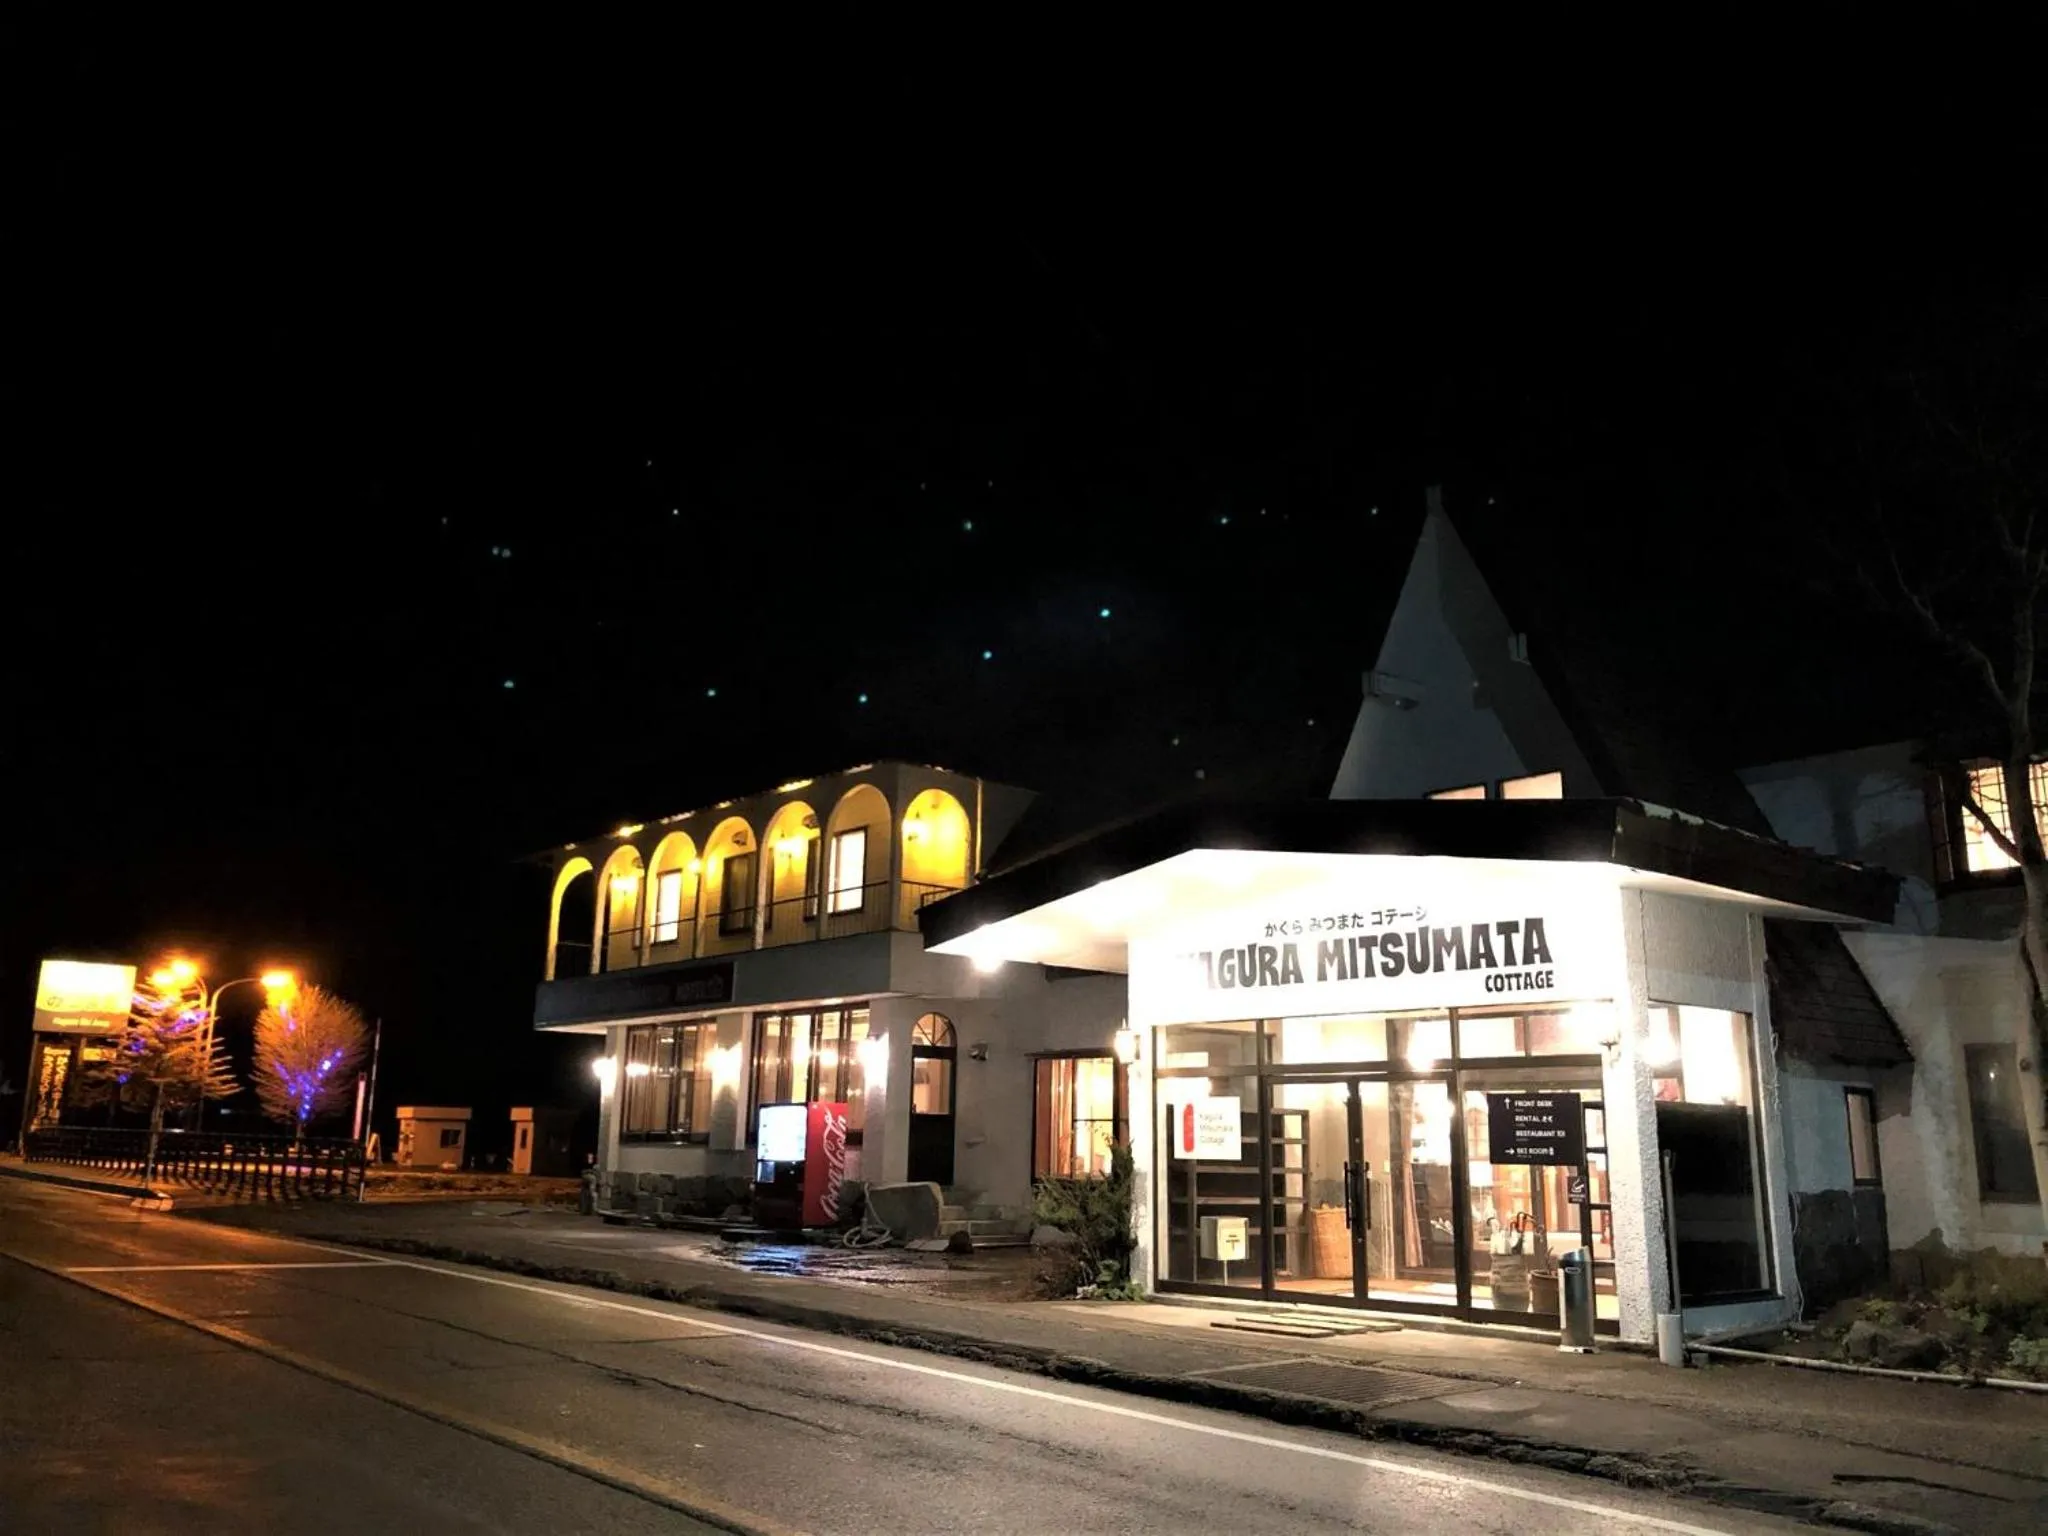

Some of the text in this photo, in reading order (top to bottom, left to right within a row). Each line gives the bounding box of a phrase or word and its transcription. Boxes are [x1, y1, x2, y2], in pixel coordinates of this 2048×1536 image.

[1309, 912, 1365, 932] みつまた
[1316, 917, 1554, 982] MITSUMATA
[1484, 970, 1554, 993] COTTAGE
